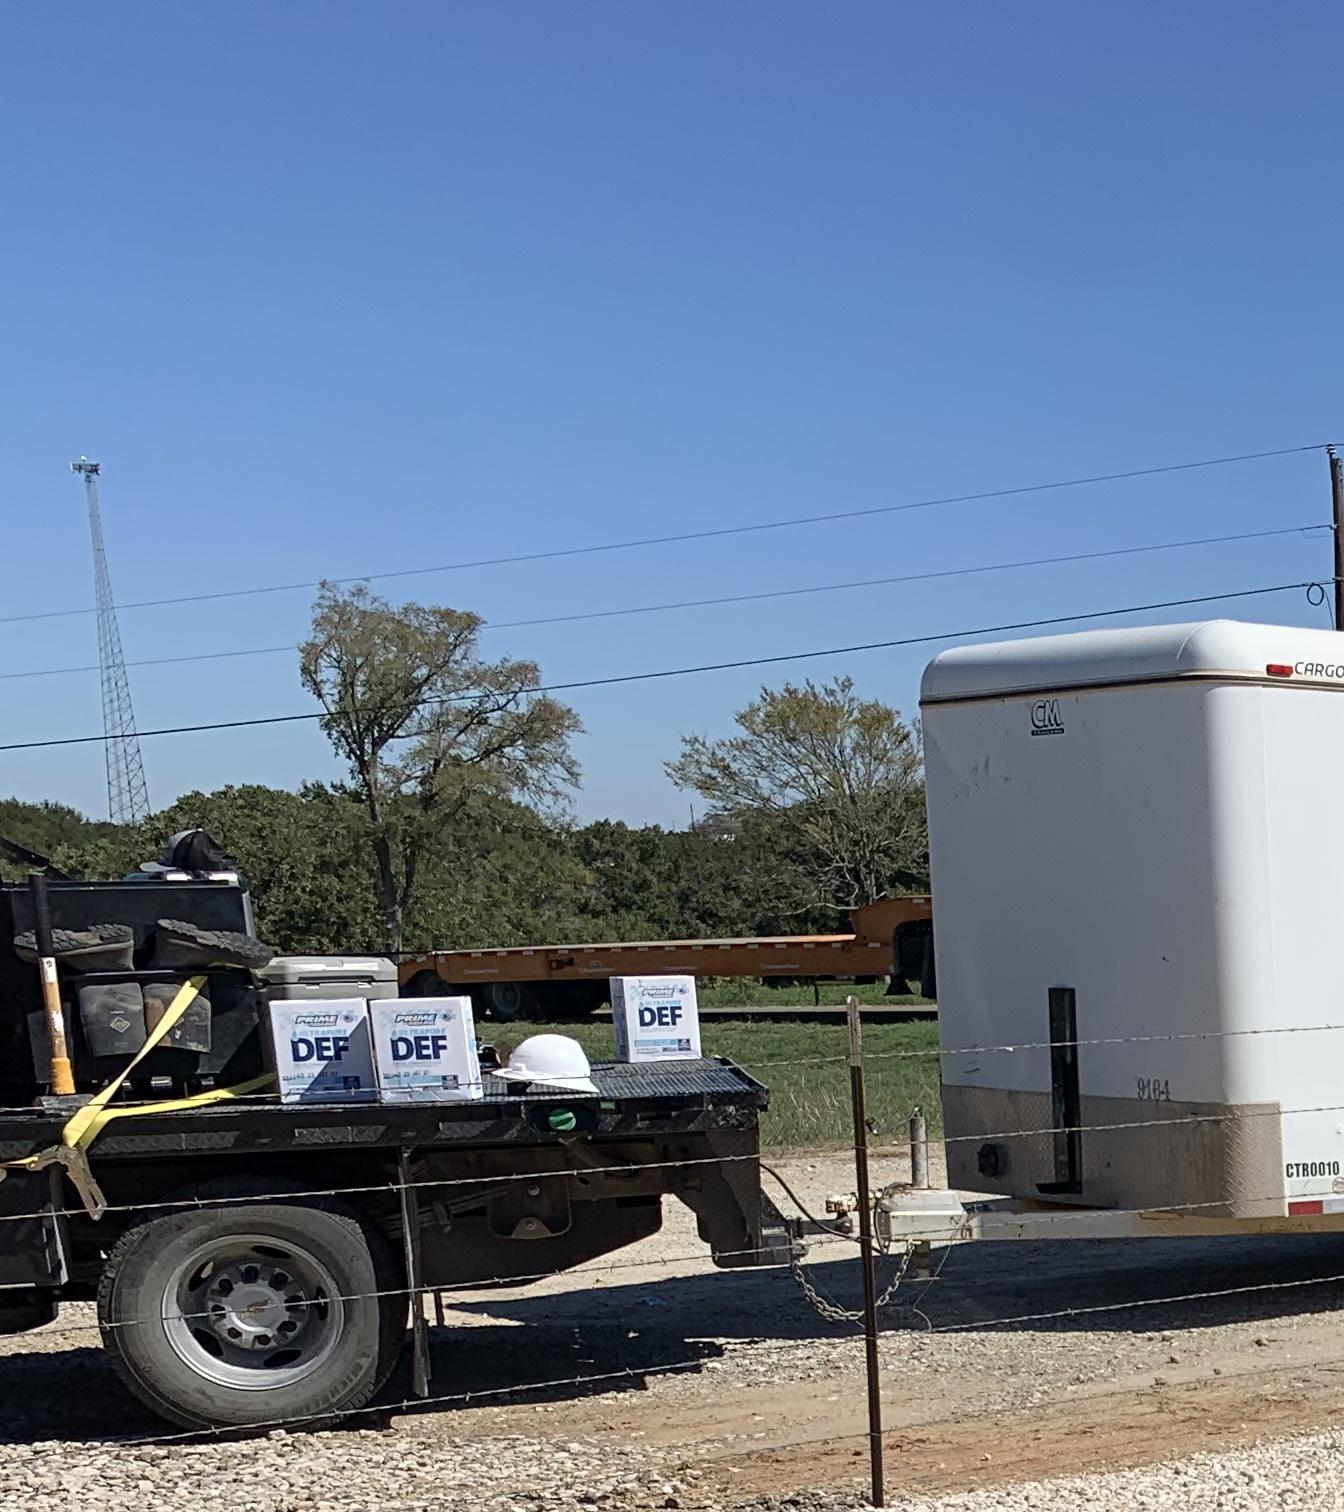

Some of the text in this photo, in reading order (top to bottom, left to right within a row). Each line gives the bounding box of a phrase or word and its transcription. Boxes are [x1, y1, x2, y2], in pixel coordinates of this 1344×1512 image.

[1031, 699, 1062, 729] CM
[295, 1014, 338, 1025] PRIME
[394, 1013, 437, 1024] PRIME
[639, 1006, 682, 1027] DEF
[290, 1036, 350, 1062] DEF
[390, 1035, 448, 1061] DEF
[1285, 1160, 1340, 1179] CTR0010
